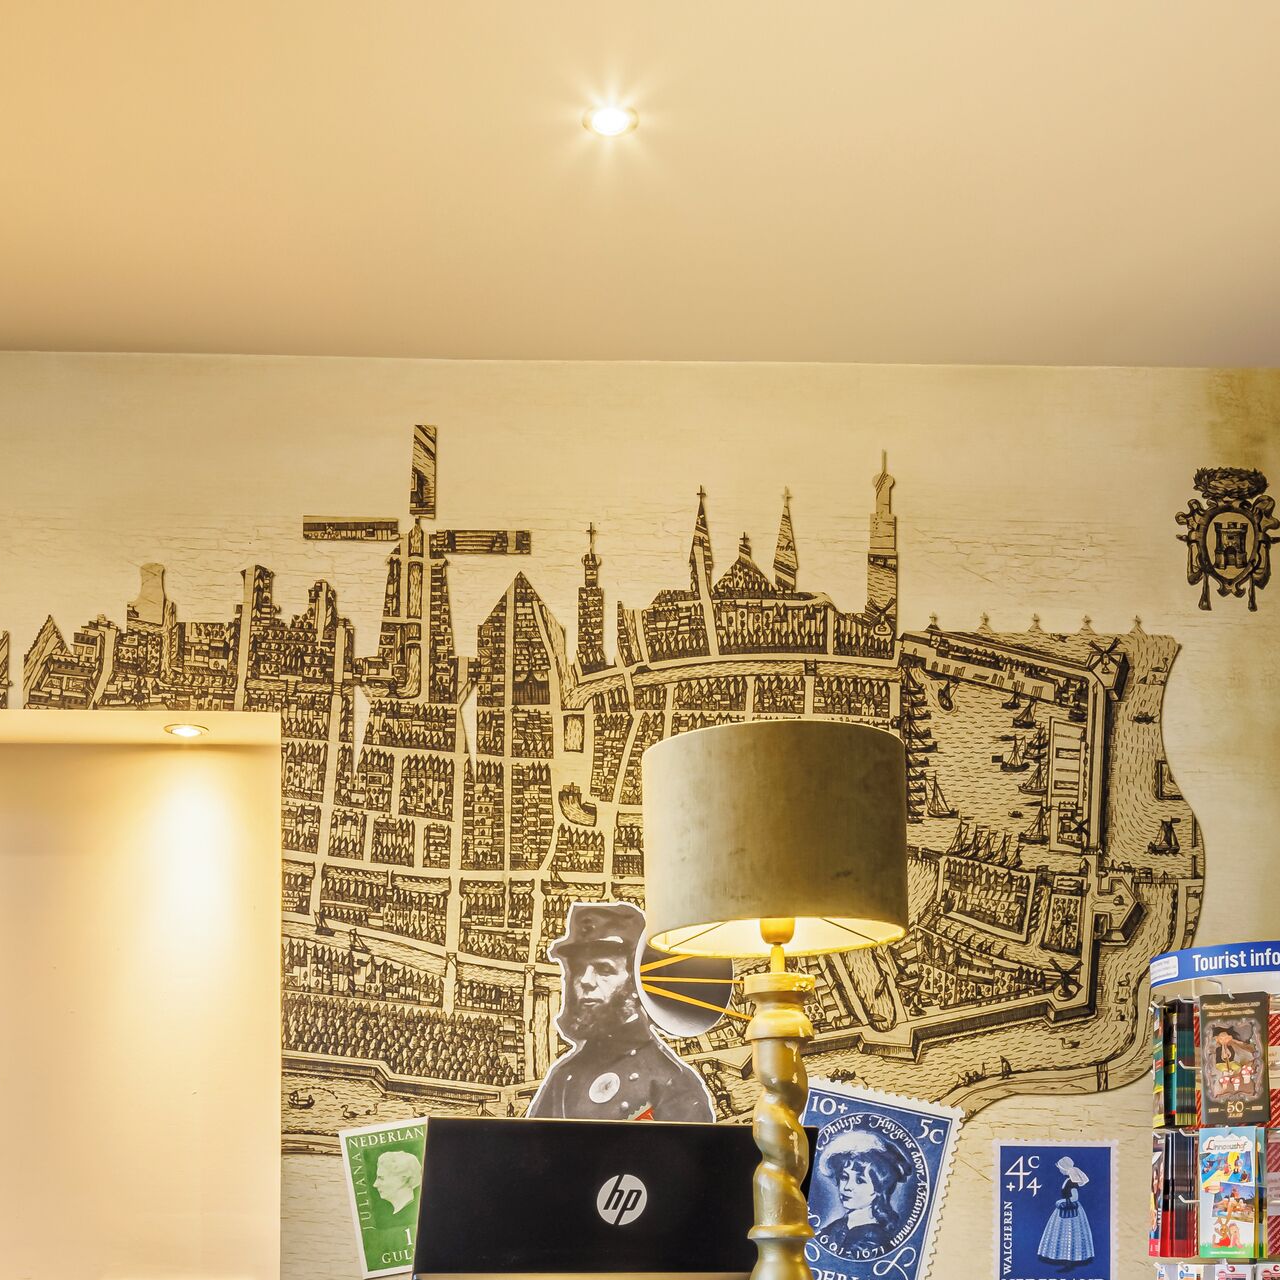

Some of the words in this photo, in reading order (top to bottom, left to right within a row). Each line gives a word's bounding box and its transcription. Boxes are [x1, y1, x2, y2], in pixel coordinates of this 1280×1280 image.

[1192, 950, 1247, 972] Tourist
[1250, 948, 1280, 967] info
[1227, 1100, 1244, 1113] 50
[816, 1114, 864, 1150] Philips
[869, 1114, 916, 1149] Huygens
[352, 1152, 377, 1230] JULIANA
[601, 1174, 640, 1225] hp
[1003, 1201, 1013, 1275] WALCHEREN
[381, 1250, 414, 1265] GUL
